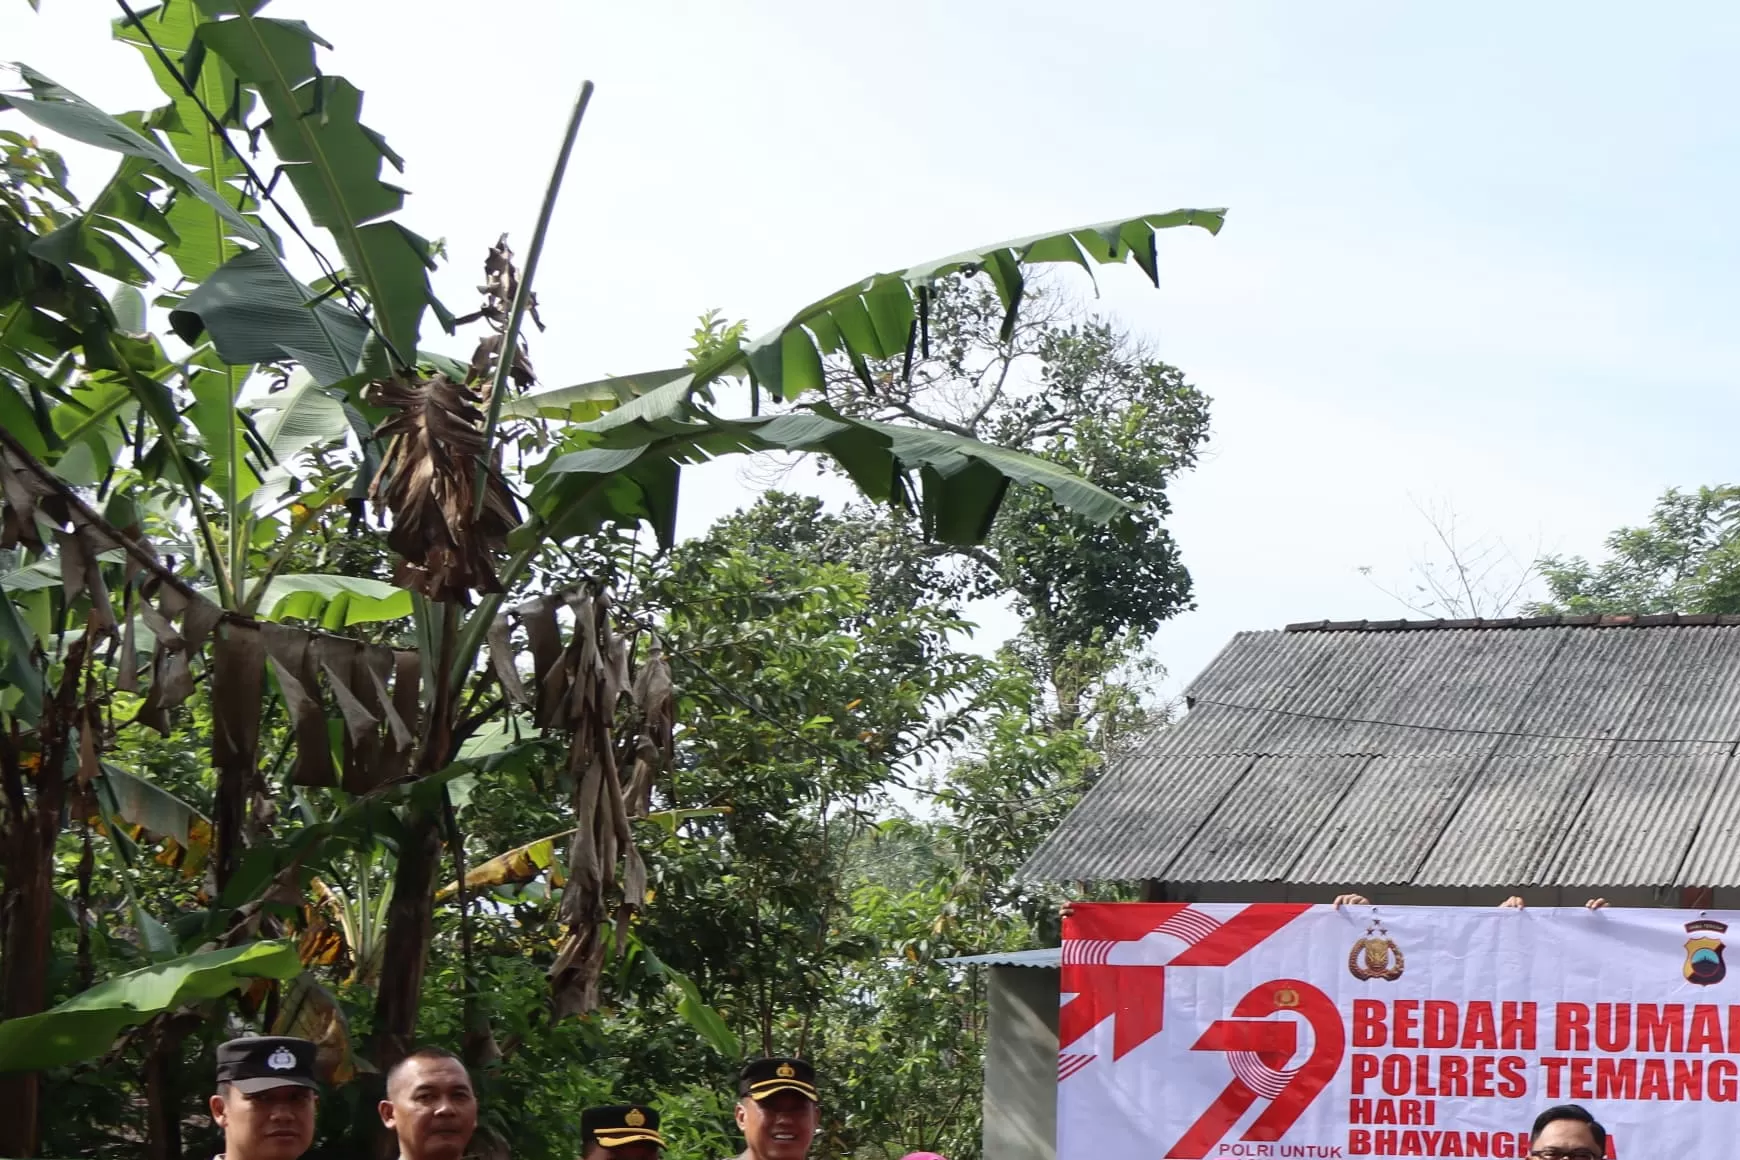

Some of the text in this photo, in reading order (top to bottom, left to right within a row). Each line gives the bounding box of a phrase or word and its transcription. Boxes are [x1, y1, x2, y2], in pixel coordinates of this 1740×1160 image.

[1352, 998, 1537, 1050] BEDAH
[1351, 1054, 1527, 1098] POLRES
[1349, 1099, 1435, 1126] HARI
[1219, 1144, 1342, 1158] POLRI UNTUK
